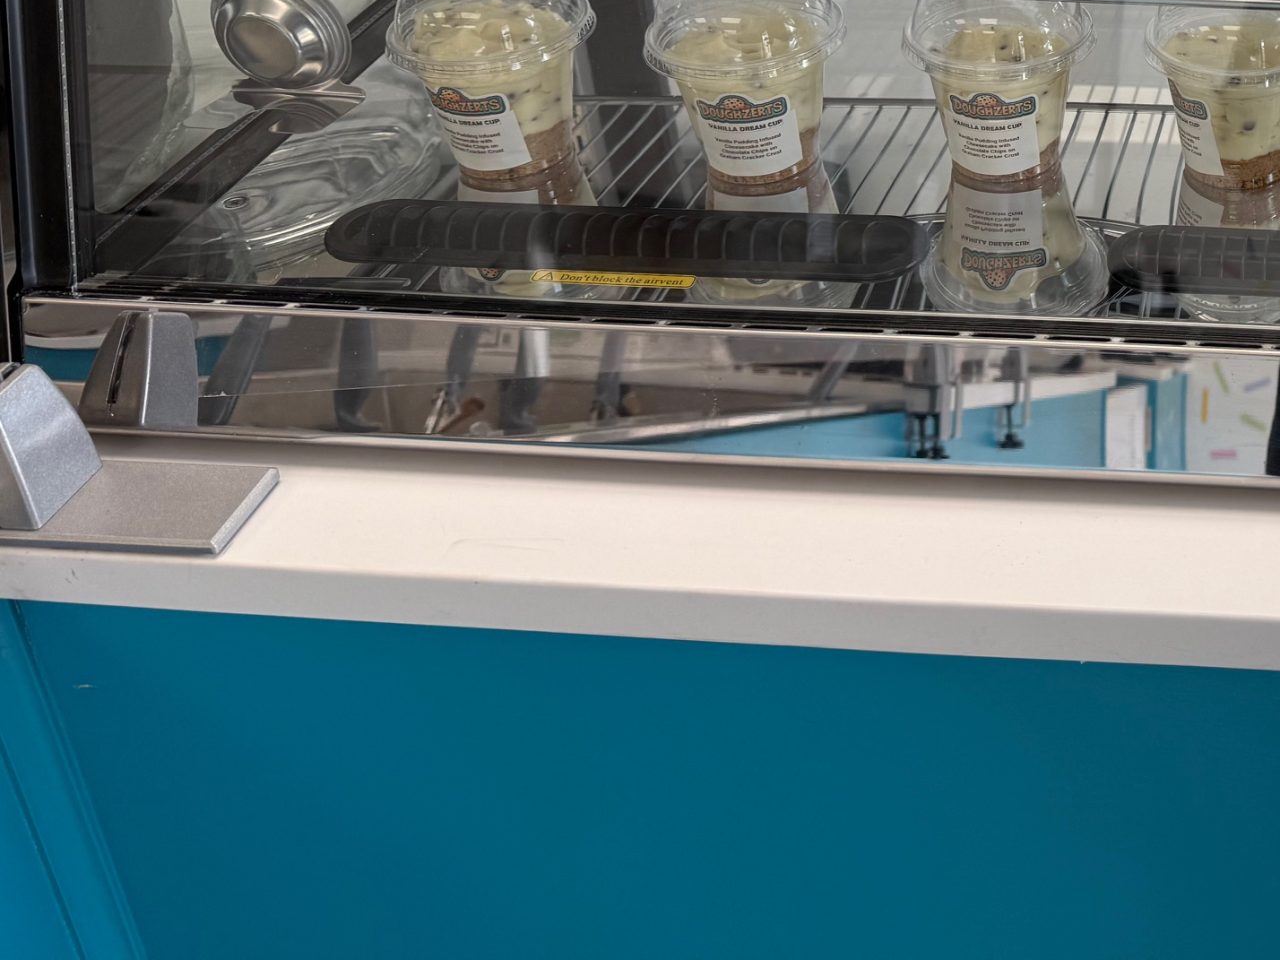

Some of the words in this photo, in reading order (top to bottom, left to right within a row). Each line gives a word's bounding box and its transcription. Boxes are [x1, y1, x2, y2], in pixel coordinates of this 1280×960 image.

[701, 101, 783, 119] DOUGHZERTS
[953, 100, 1032, 116] DOUGHZERTS
[708, 123, 738, 132] VANILLA
[739, 124, 766, 132] DREAM
[767, 119, 783, 127] CUP
[953, 119, 979, 130] VANILLA
[559, 273, 592, 281] Don't
[592, 275, 622, 283] block
[624, 277, 643, 285] the
